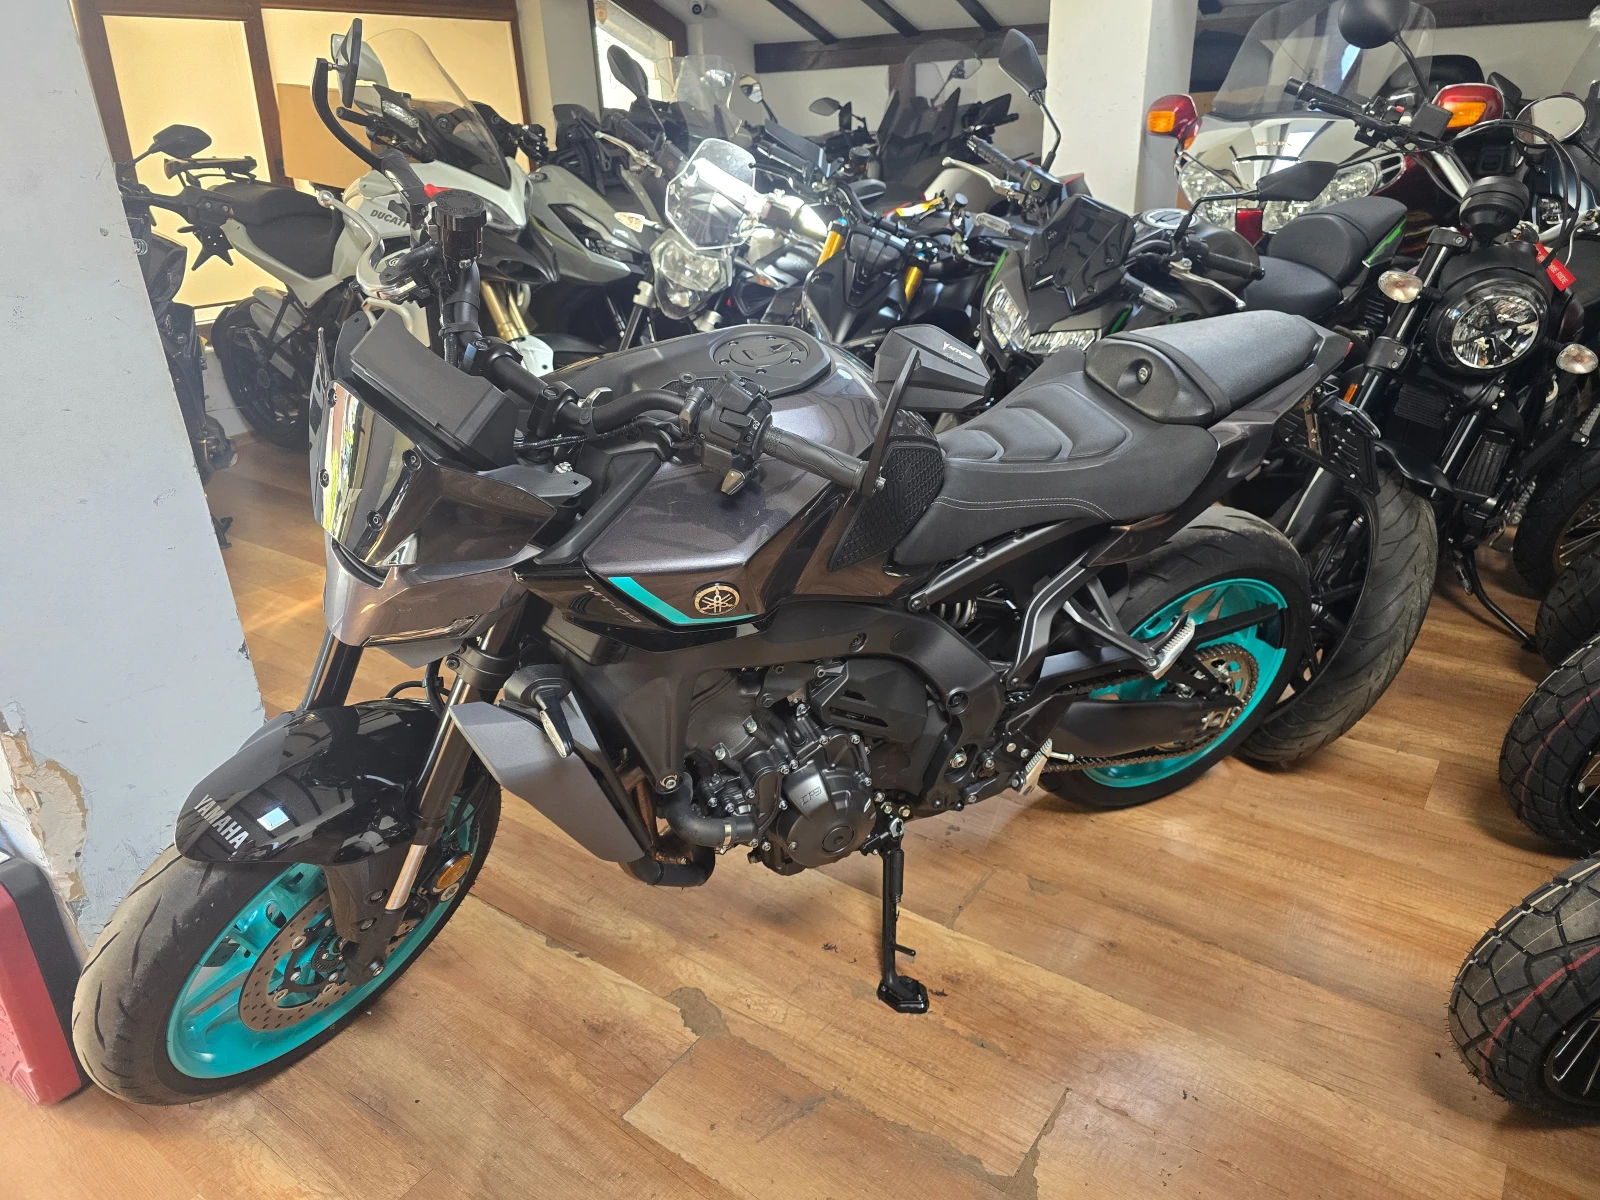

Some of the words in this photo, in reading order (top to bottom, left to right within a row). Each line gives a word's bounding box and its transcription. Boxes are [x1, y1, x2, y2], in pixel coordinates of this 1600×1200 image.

[1555, 271, 1569, 285] RIDE
[583, 585, 642, 623] MT-09
[194, 794, 249, 849] YAMAHA
